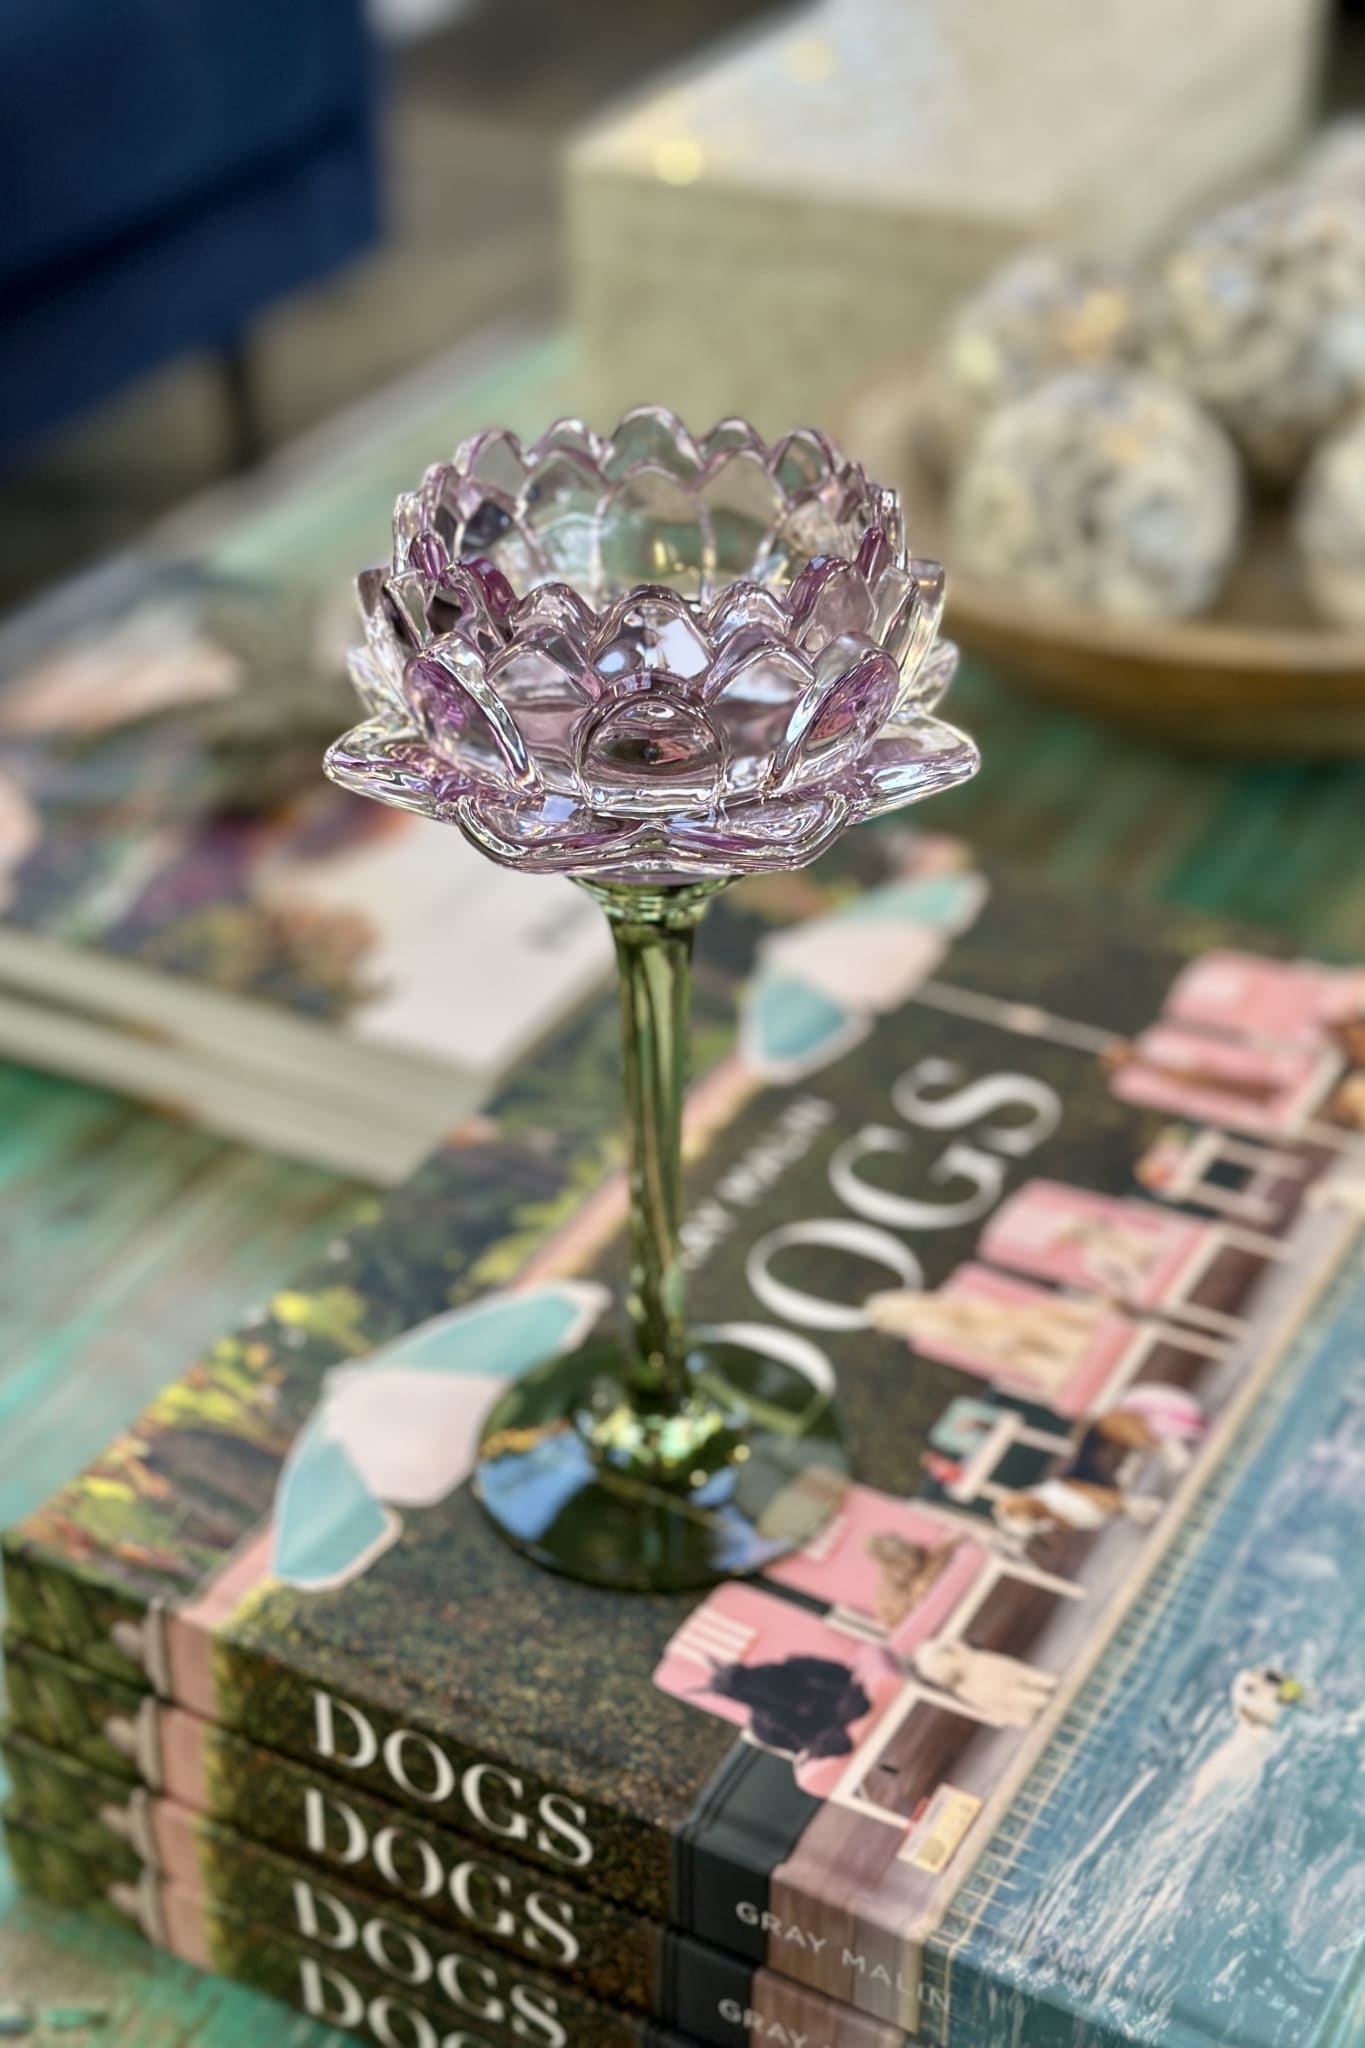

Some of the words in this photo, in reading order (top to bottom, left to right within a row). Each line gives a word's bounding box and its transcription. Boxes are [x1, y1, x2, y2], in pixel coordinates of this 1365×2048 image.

[311, 1691, 594, 1867] DOGS
[303, 1788, 580, 1963] DOGS
[293, 1880, 567, 2048] DOGS
[300, 1957, 495, 2048] DO
[718, 1997, 808, 2048] GRAY
[735, 1901, 827, 1953] GRAY
[841, 1949, 948, 2009] MALIN
